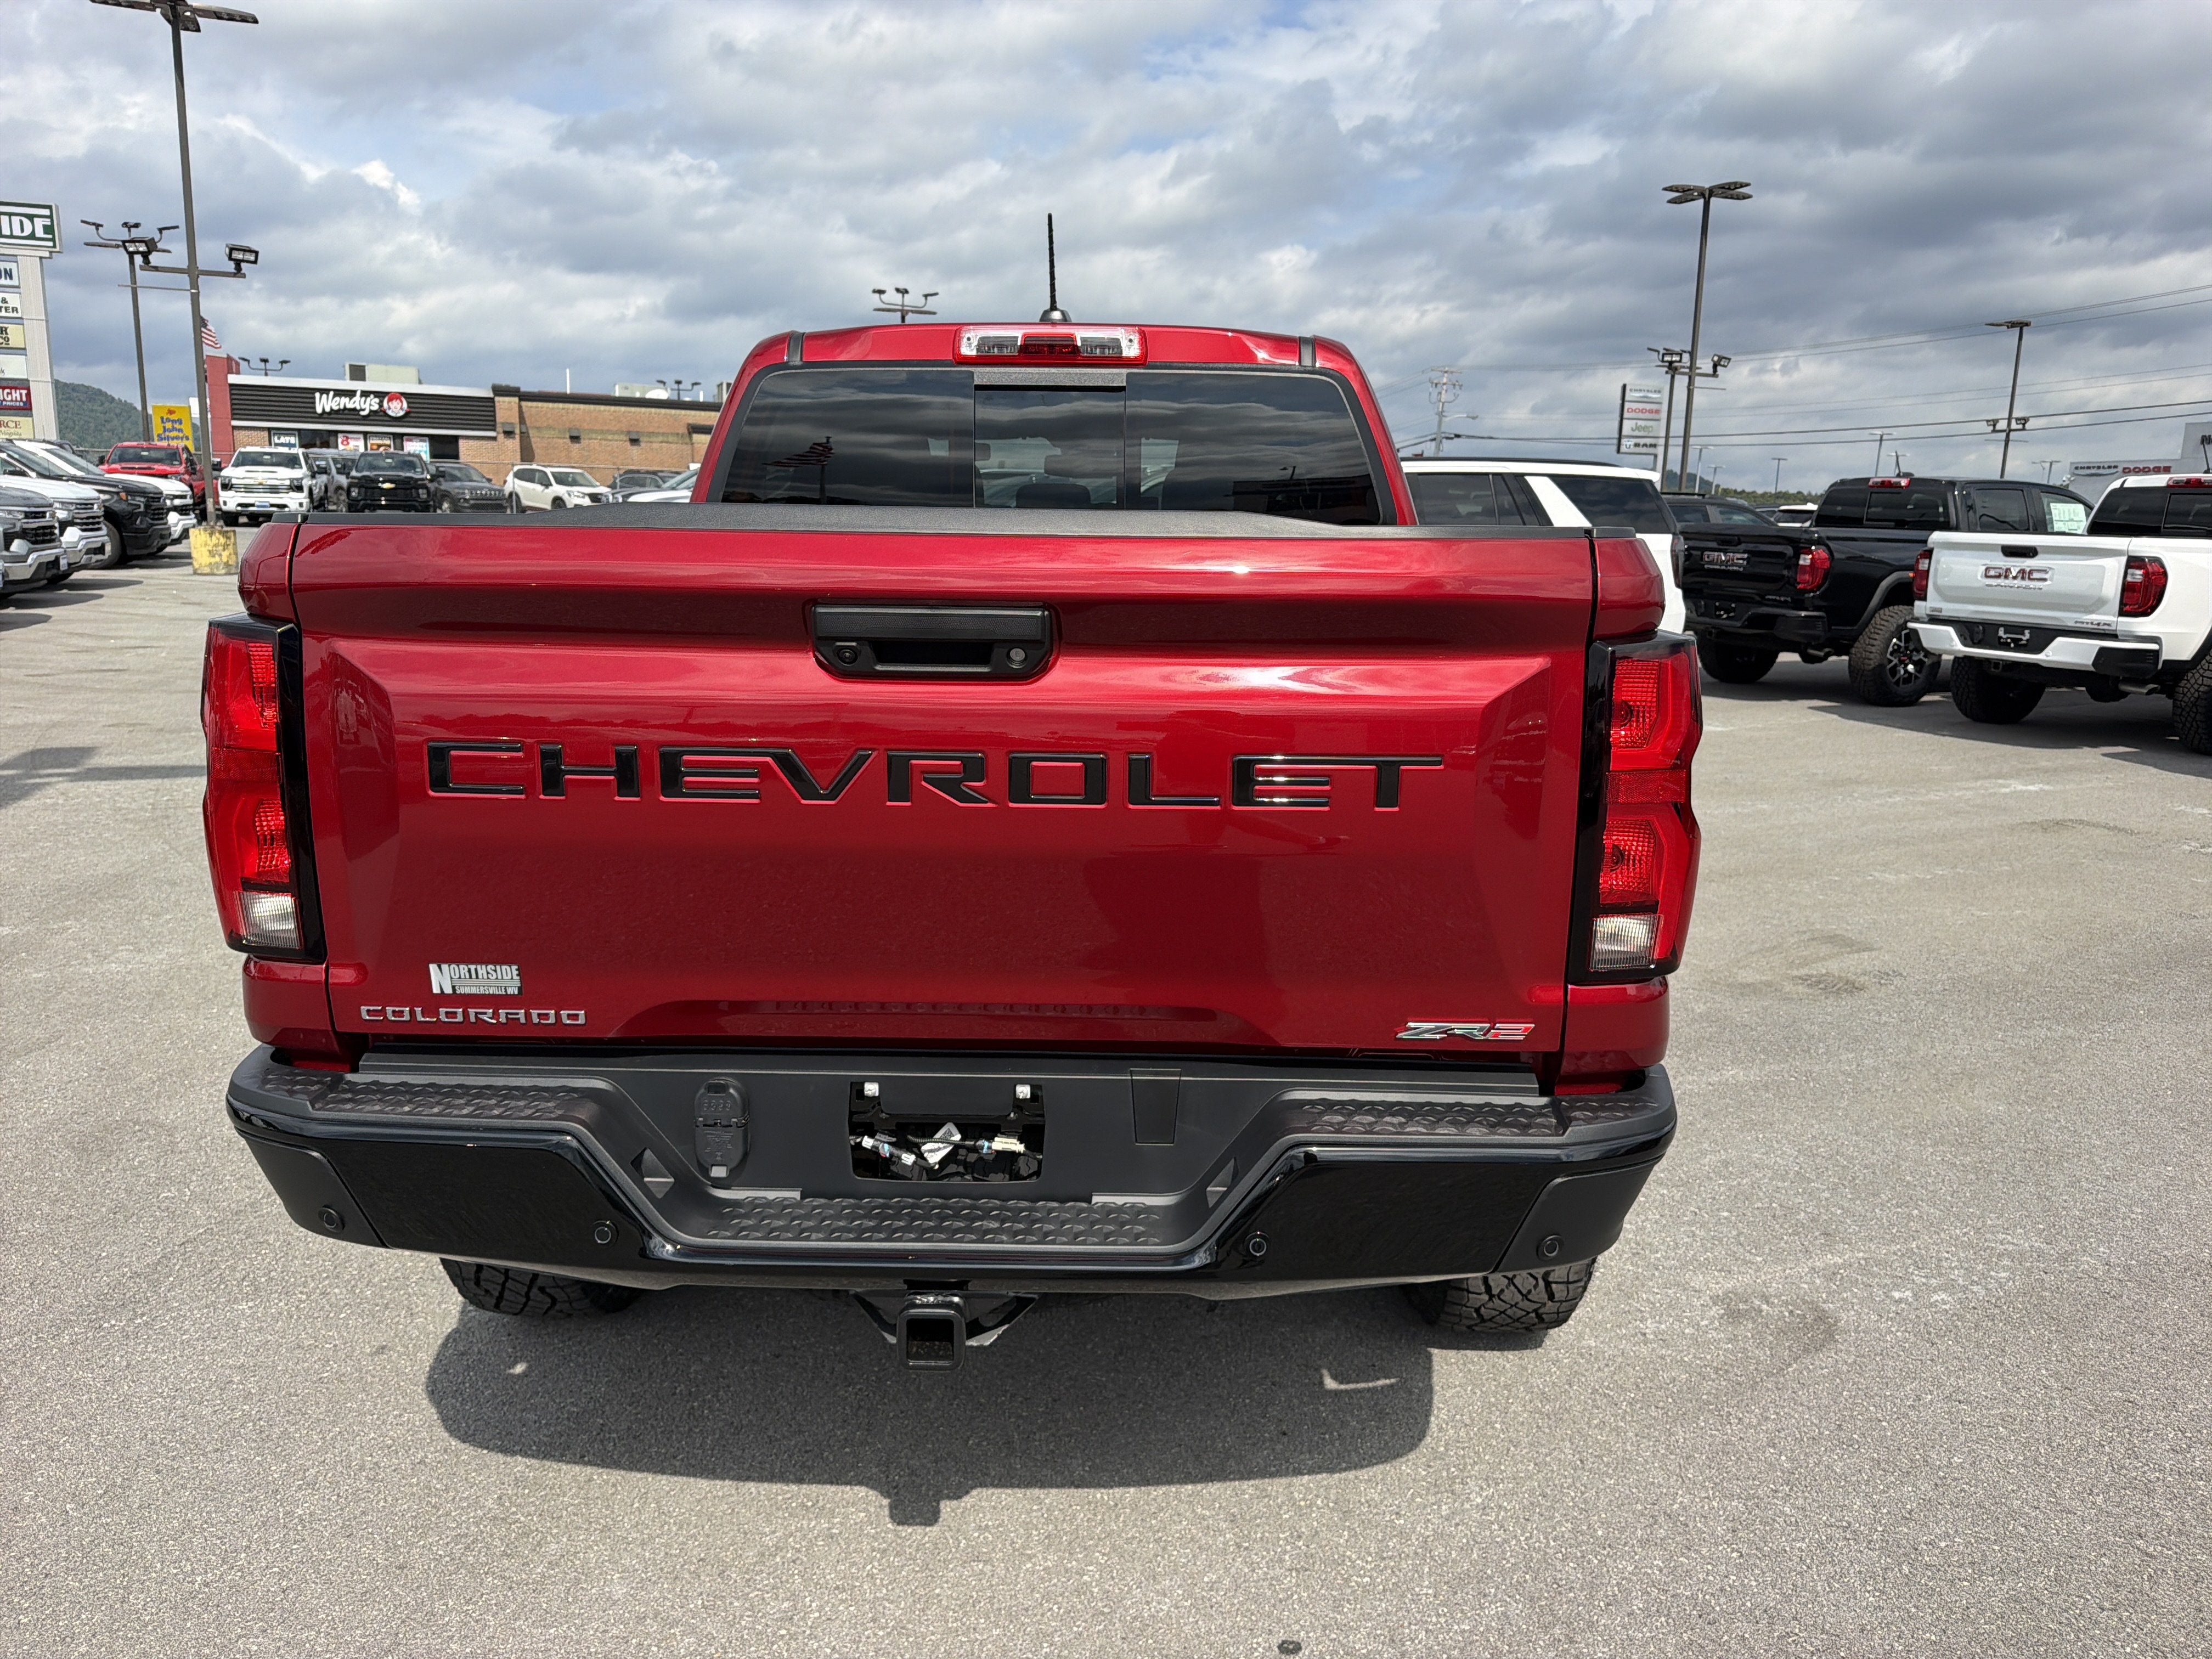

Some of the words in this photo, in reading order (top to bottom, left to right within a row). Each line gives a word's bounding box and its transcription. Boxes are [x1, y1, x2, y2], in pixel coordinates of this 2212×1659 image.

[1, 215, 53, 238] IDE
[314, 390, 379, 415] Wendy's
[160, 416, 183, 425] Long
[162, 425, 183, 433] John
[1632, 423, 1653, 434] Jeep
[2200, 435, 2212, 445] N
[1703, 551, 1748, 565] GMC
[1984, 566, 2049, 582] GMC
[427, 741, 1444, 811] CHEVROLET
[429, 963, 520, 994] NORTHSIDE
[455, 986, 506, 995] SUMMERSVILLE
[506, 986, 518, 995] WV
[360, 1006, 587, 1025] COLORADO
